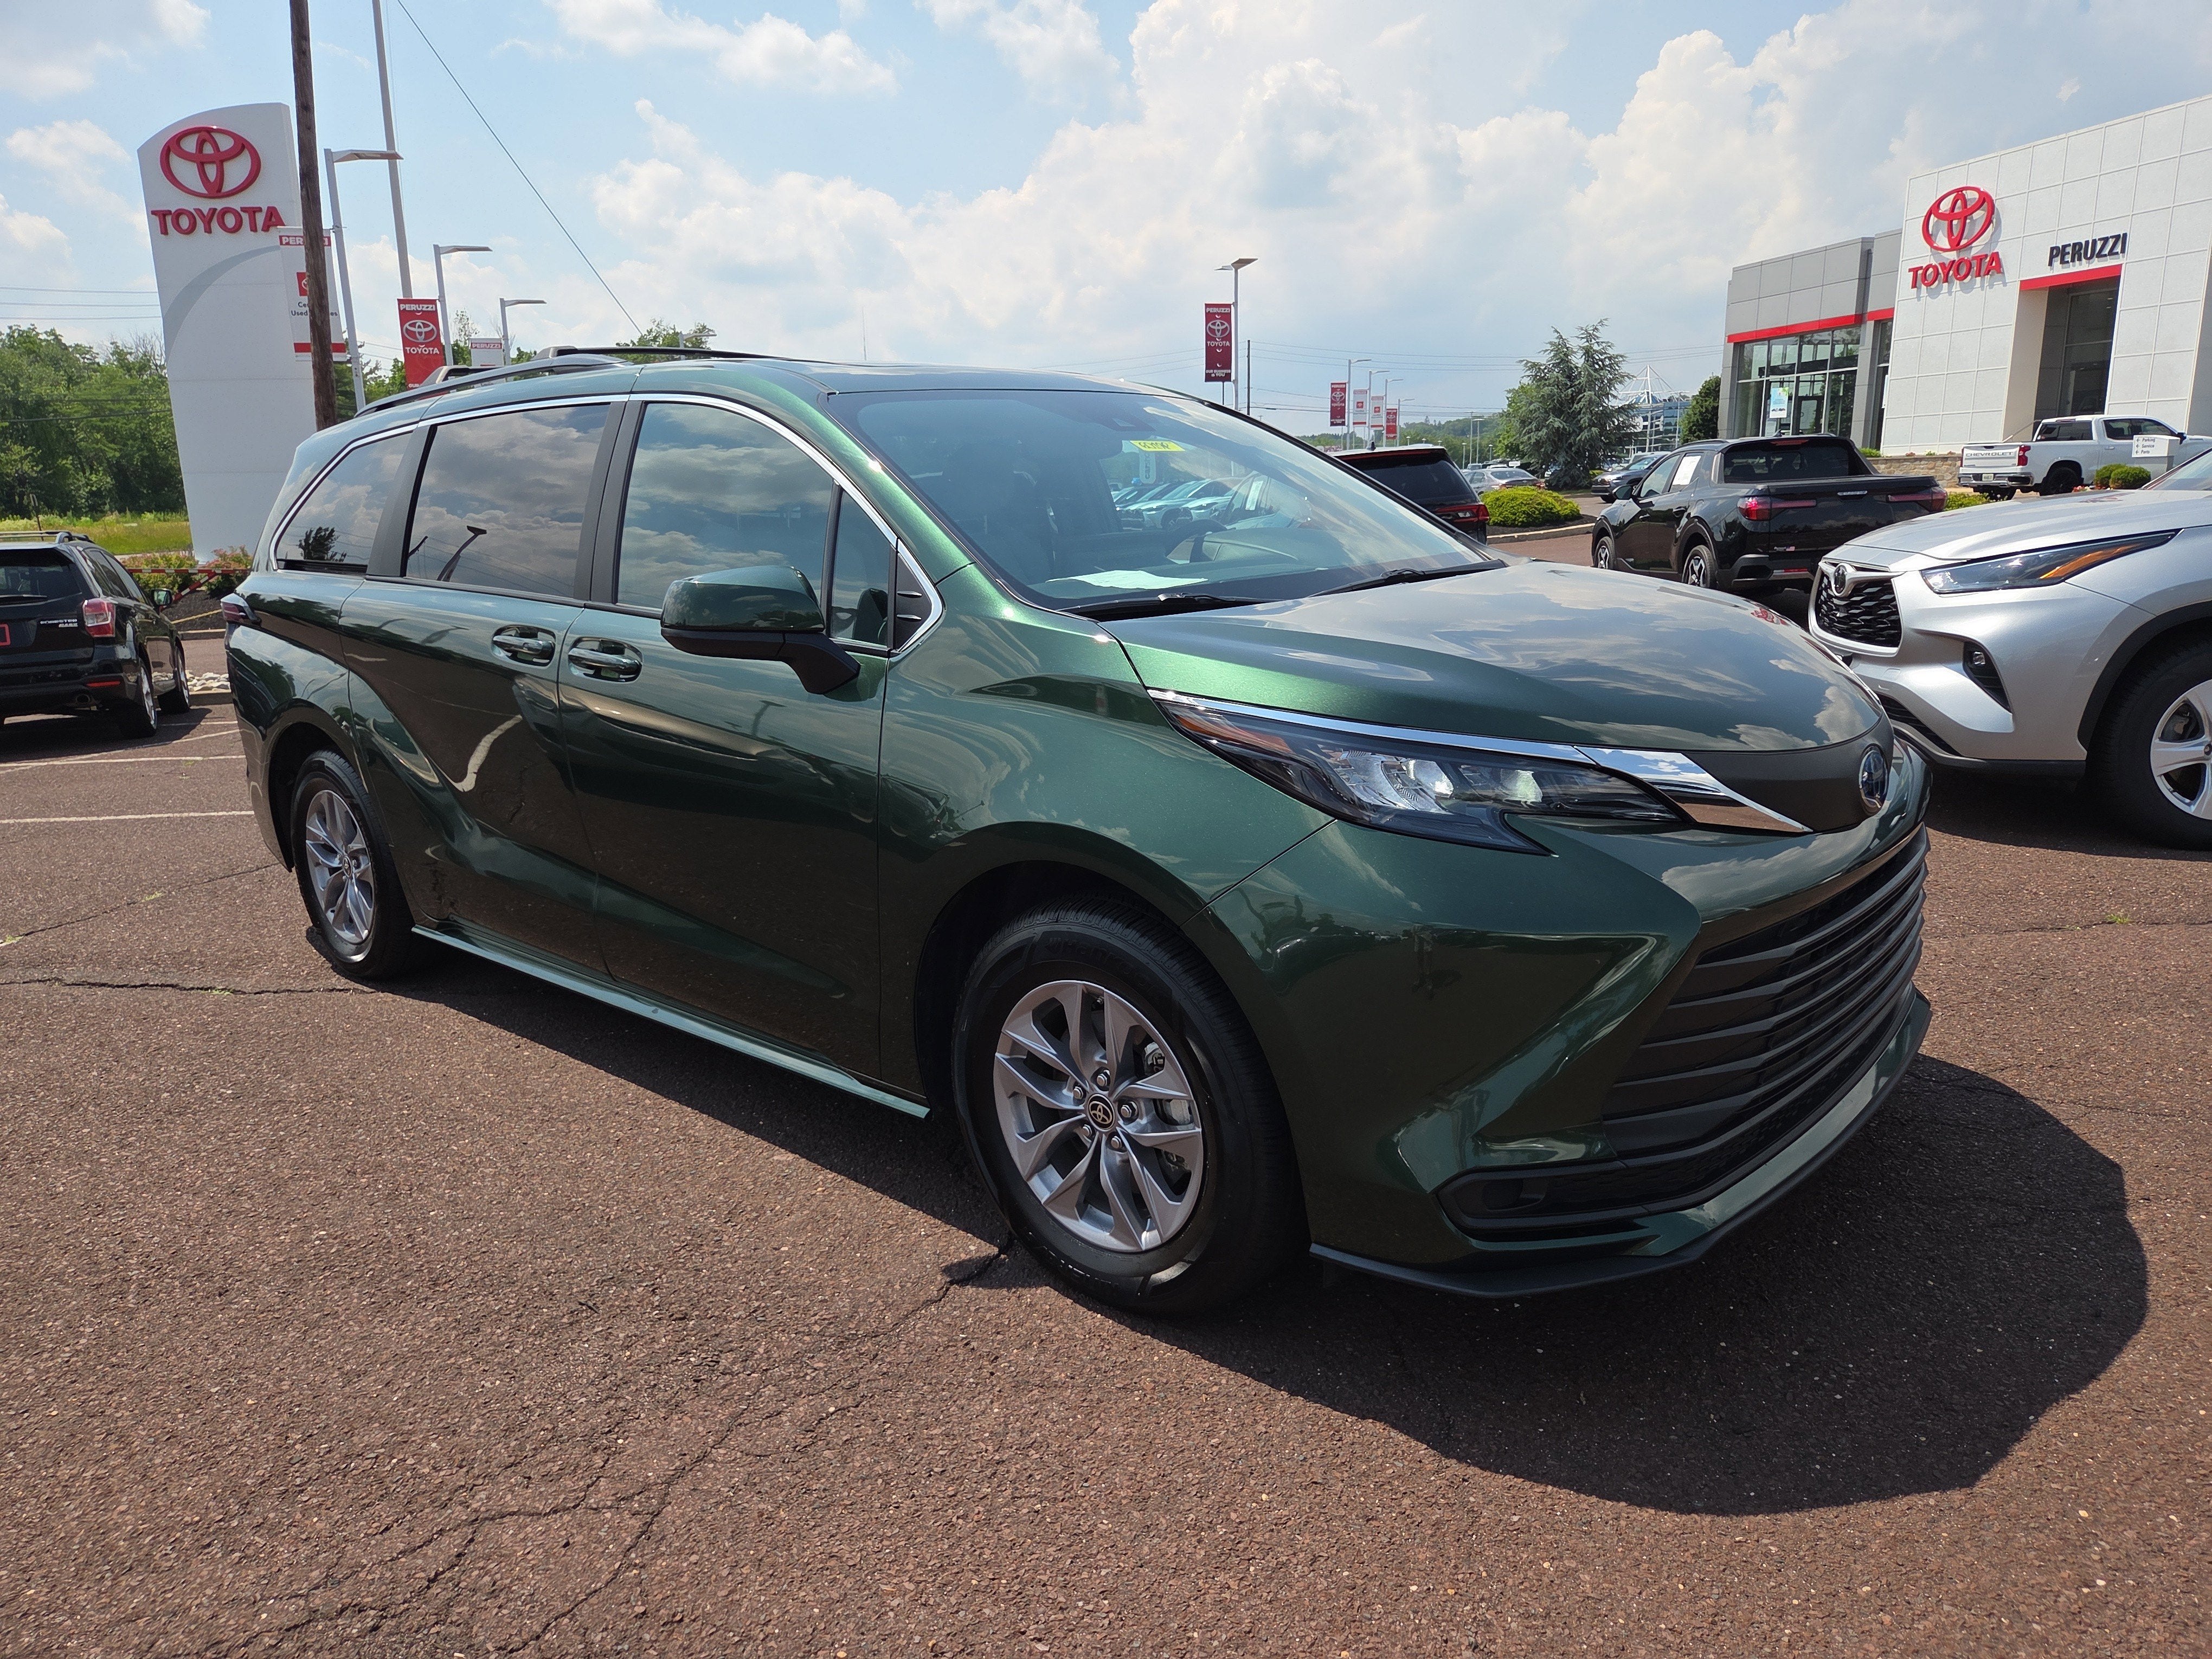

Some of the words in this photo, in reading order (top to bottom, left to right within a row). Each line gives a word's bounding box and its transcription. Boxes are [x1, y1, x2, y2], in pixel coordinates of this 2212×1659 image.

[151, 205, 286, 236] TOYOTA
[2048, 232, 2127, 267] PERUZZI
[1908, 251, 2002, 289] TOYOTA
[405, 346, 440, 355] TOYOTA
